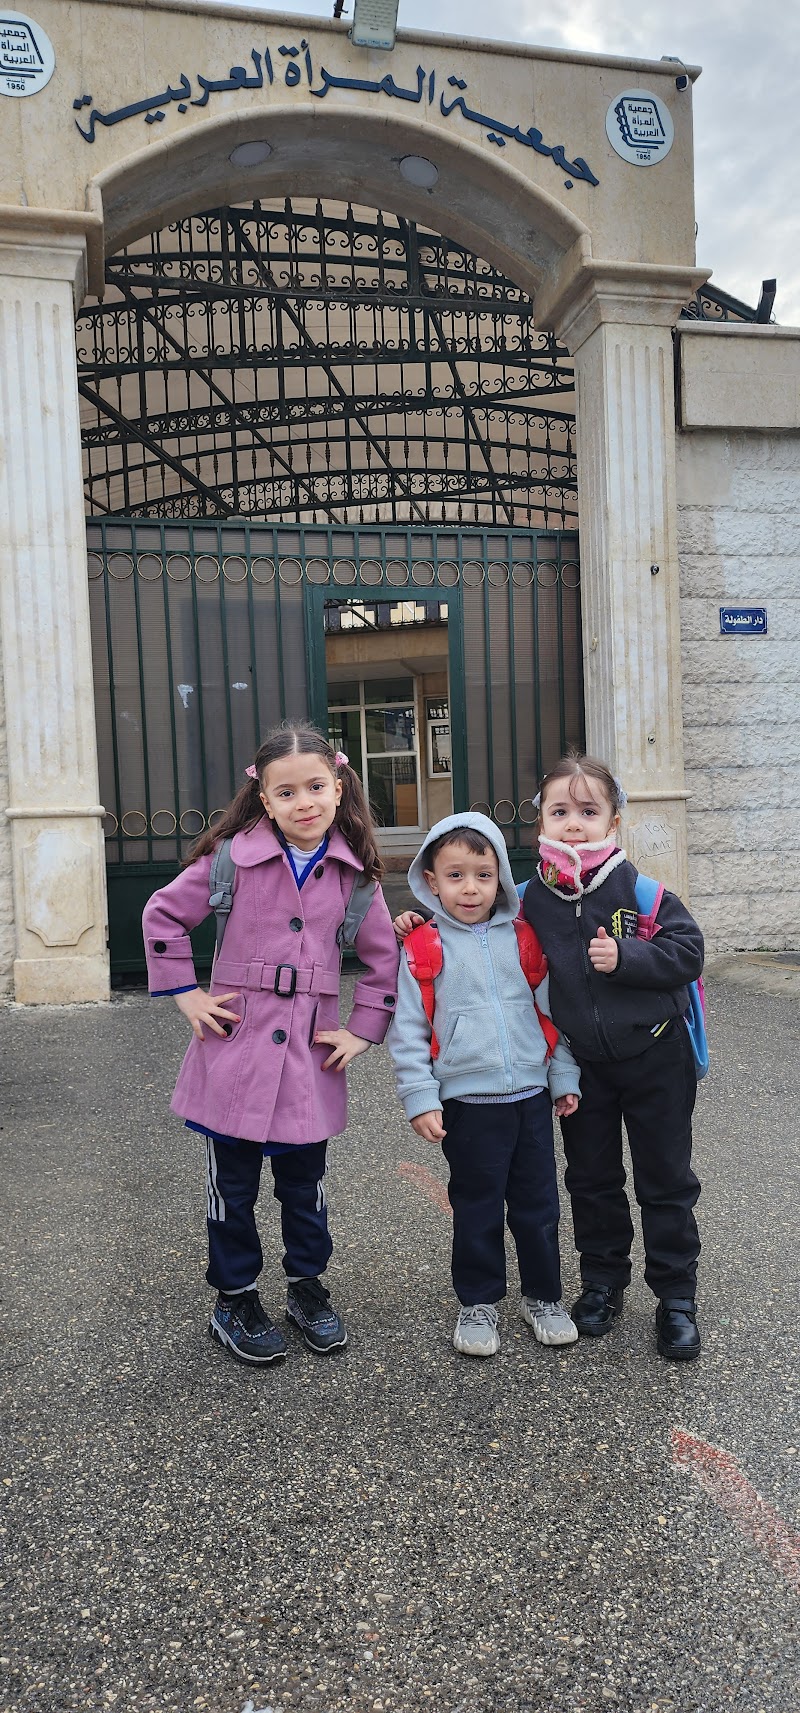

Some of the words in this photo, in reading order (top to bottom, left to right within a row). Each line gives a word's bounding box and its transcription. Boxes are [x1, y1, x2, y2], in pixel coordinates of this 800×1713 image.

[0, 29, 27, 39] جمعي
[1, 40, 30, 52] المرأة
[3, 53, 36, 64] العربية
[278, 39, 435, 106] المرأة
[7, 82, 25, 91] 1950
[73, 46, 274, 143] العربية
[628, 104, 653, 114] جمعية
[632, 115, 655, 126] المرأة
[440, 75, 599, 190] جمعية
[634, 128, 659, 137] العربية
[725, 615, 752, 626] الطفولة
[753, 615, 763, 626] دار
